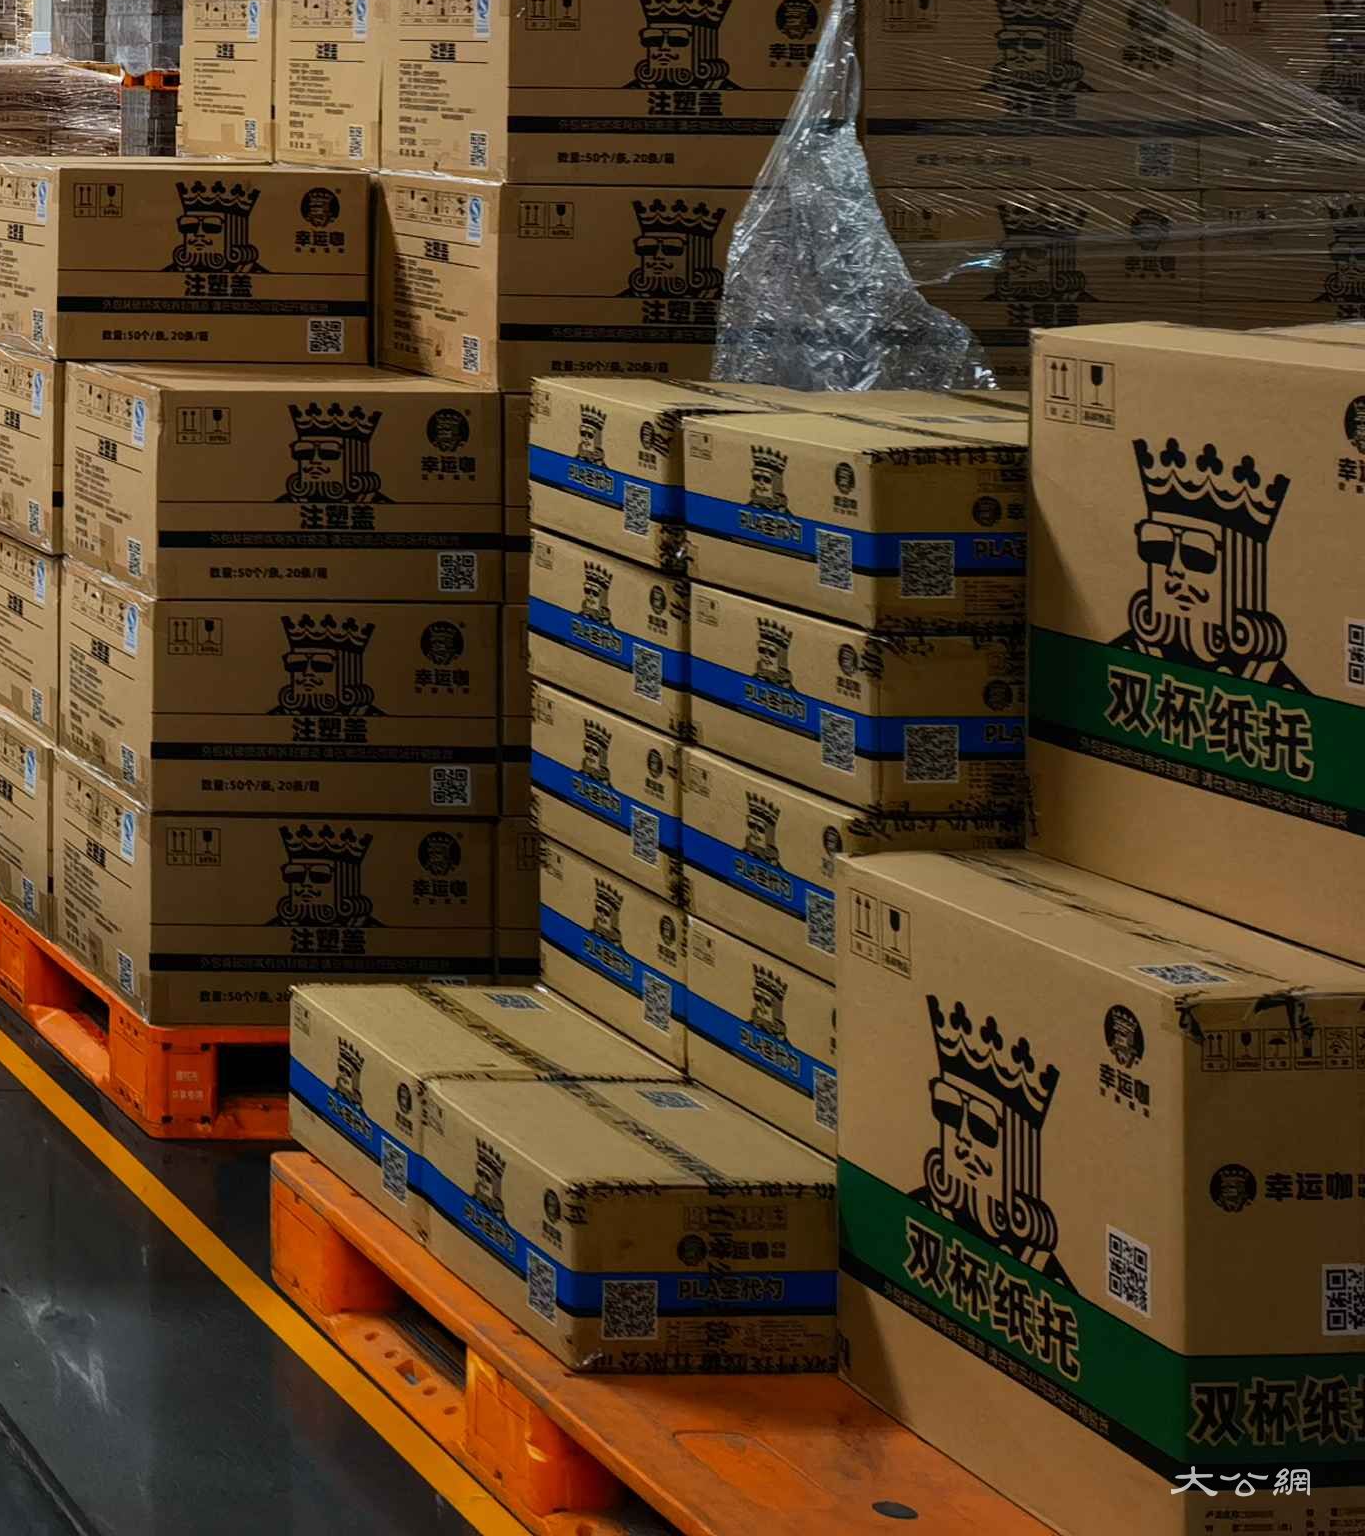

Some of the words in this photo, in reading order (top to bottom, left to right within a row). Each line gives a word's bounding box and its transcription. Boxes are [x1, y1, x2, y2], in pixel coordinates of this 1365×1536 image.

[647, 91, 723, 116] 注塑盖
[184, 274, 253, 298] 注塑盖
[299, 505, 375, 531] 注塑盖
[292, 717, 368, 743] 注塑盖
[1105, 664, 1314, 781] 双杯纸托
[290, 928, 367, 955] 注塑盖
[1099, 1063, 1150, 1105] 幸运咖
[1264, 1171, 1353, 1202] 幸运咖
[905, 1216, 1081, 1382] 双杯纸托
